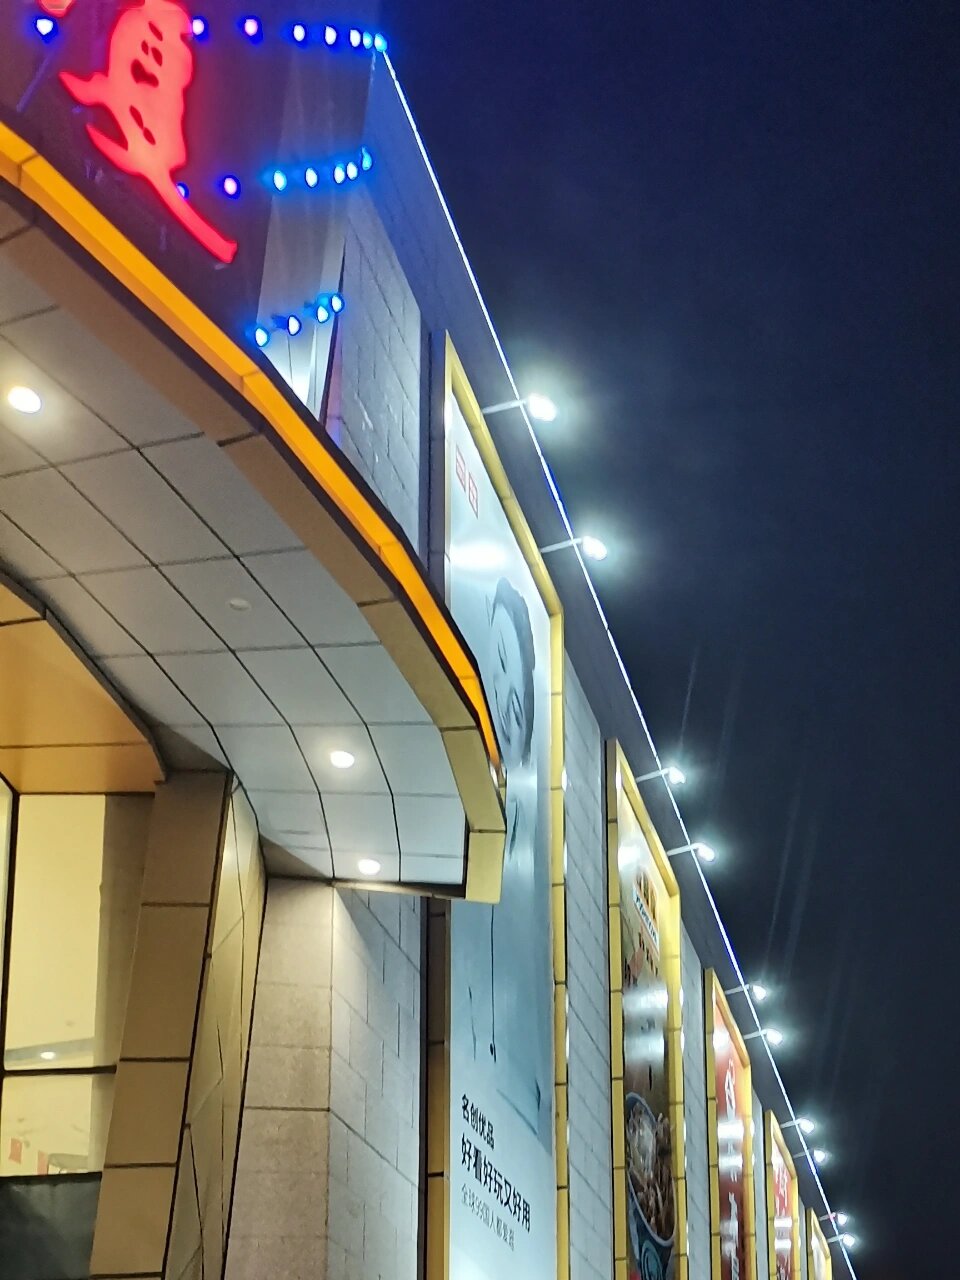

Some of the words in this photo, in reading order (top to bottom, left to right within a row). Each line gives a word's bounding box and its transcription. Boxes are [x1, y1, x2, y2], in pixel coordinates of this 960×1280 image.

[461, 1093, 495, 1150] 名创优品
[461, 1132, 531, 1233] 好看好玩又好用
